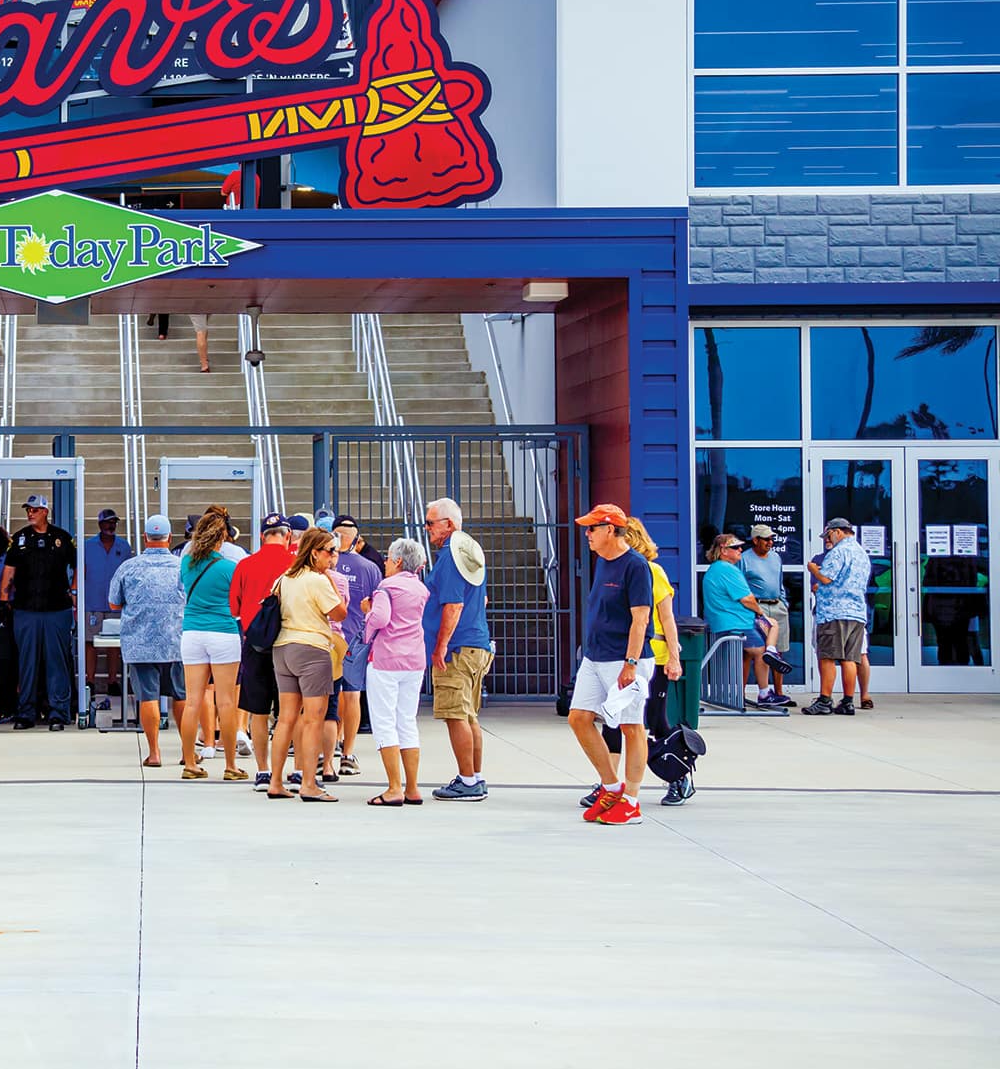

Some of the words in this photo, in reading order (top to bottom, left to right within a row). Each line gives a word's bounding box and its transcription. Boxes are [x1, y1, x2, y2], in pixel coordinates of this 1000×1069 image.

[750, 504, 771, 512] Store
[772, 504, 796, 512] Hours
[754, 514, 772, 522] Mon
[778, 514, 791, 522] Sat
[778, 524, 796, 533] 4pm
